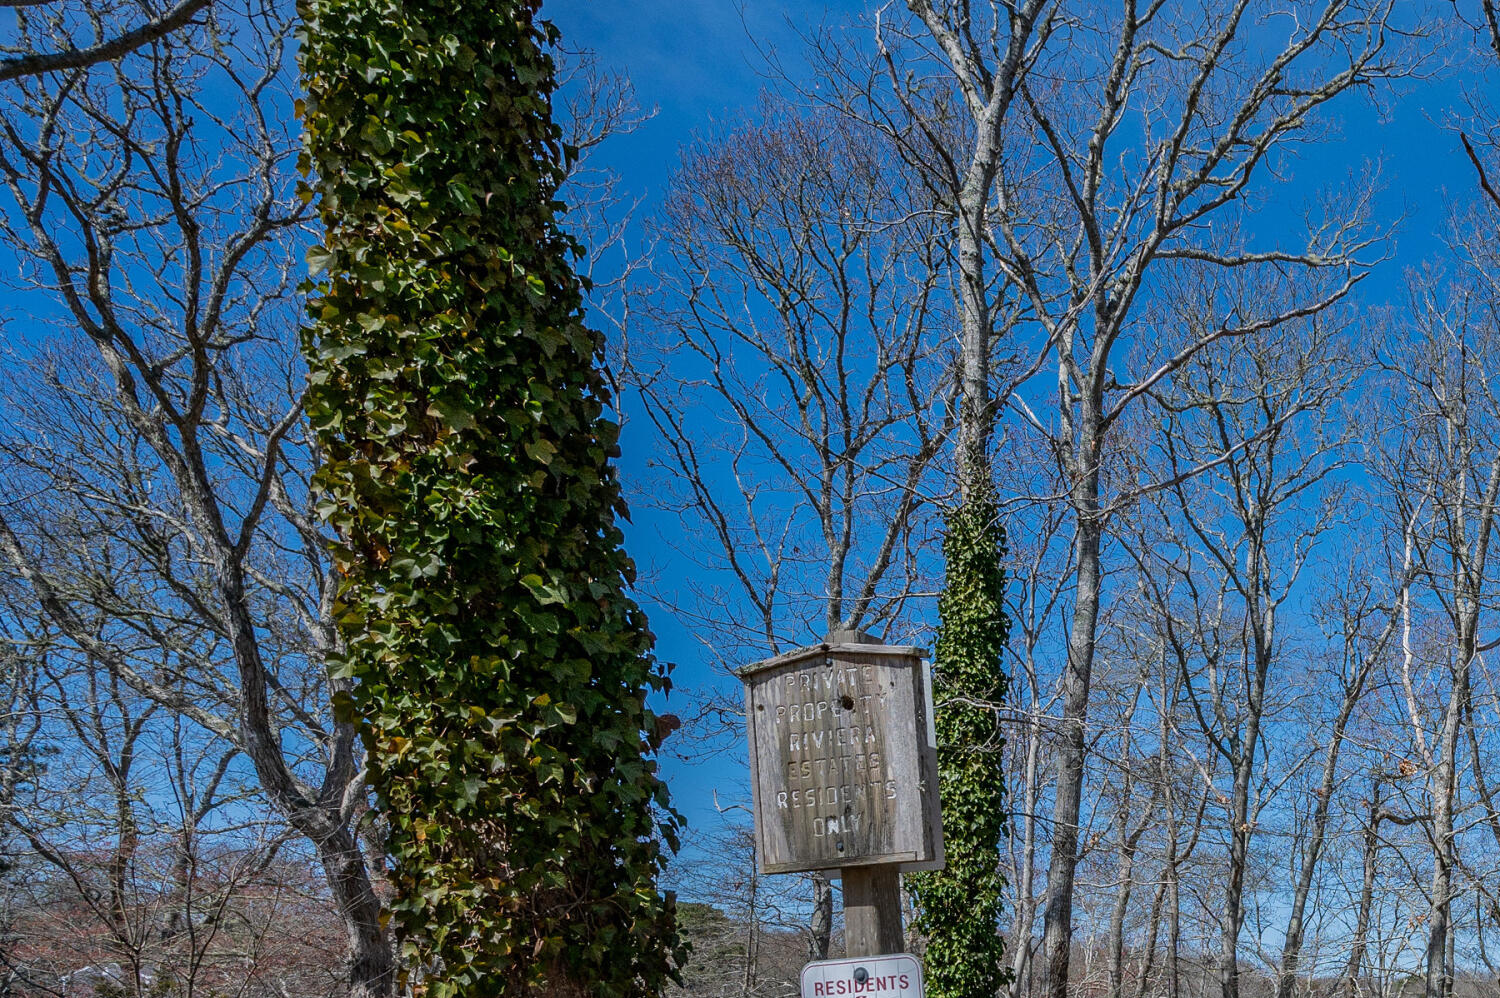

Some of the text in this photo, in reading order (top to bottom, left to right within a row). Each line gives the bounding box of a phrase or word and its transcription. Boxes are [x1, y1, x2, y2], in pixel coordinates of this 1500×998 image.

[785, 666, 873, 691] PRIVATE
[775, 692, 888, 724] PROPETY
[789, 727, 876, 751] RIVIERA
[787, 753, 880, 780] ESTATES
[777, 781, 897, 809] RESIDENTS
[813, 812, 863, 837] ONLY
[814, 975, 909, 996] RESIDENTS
